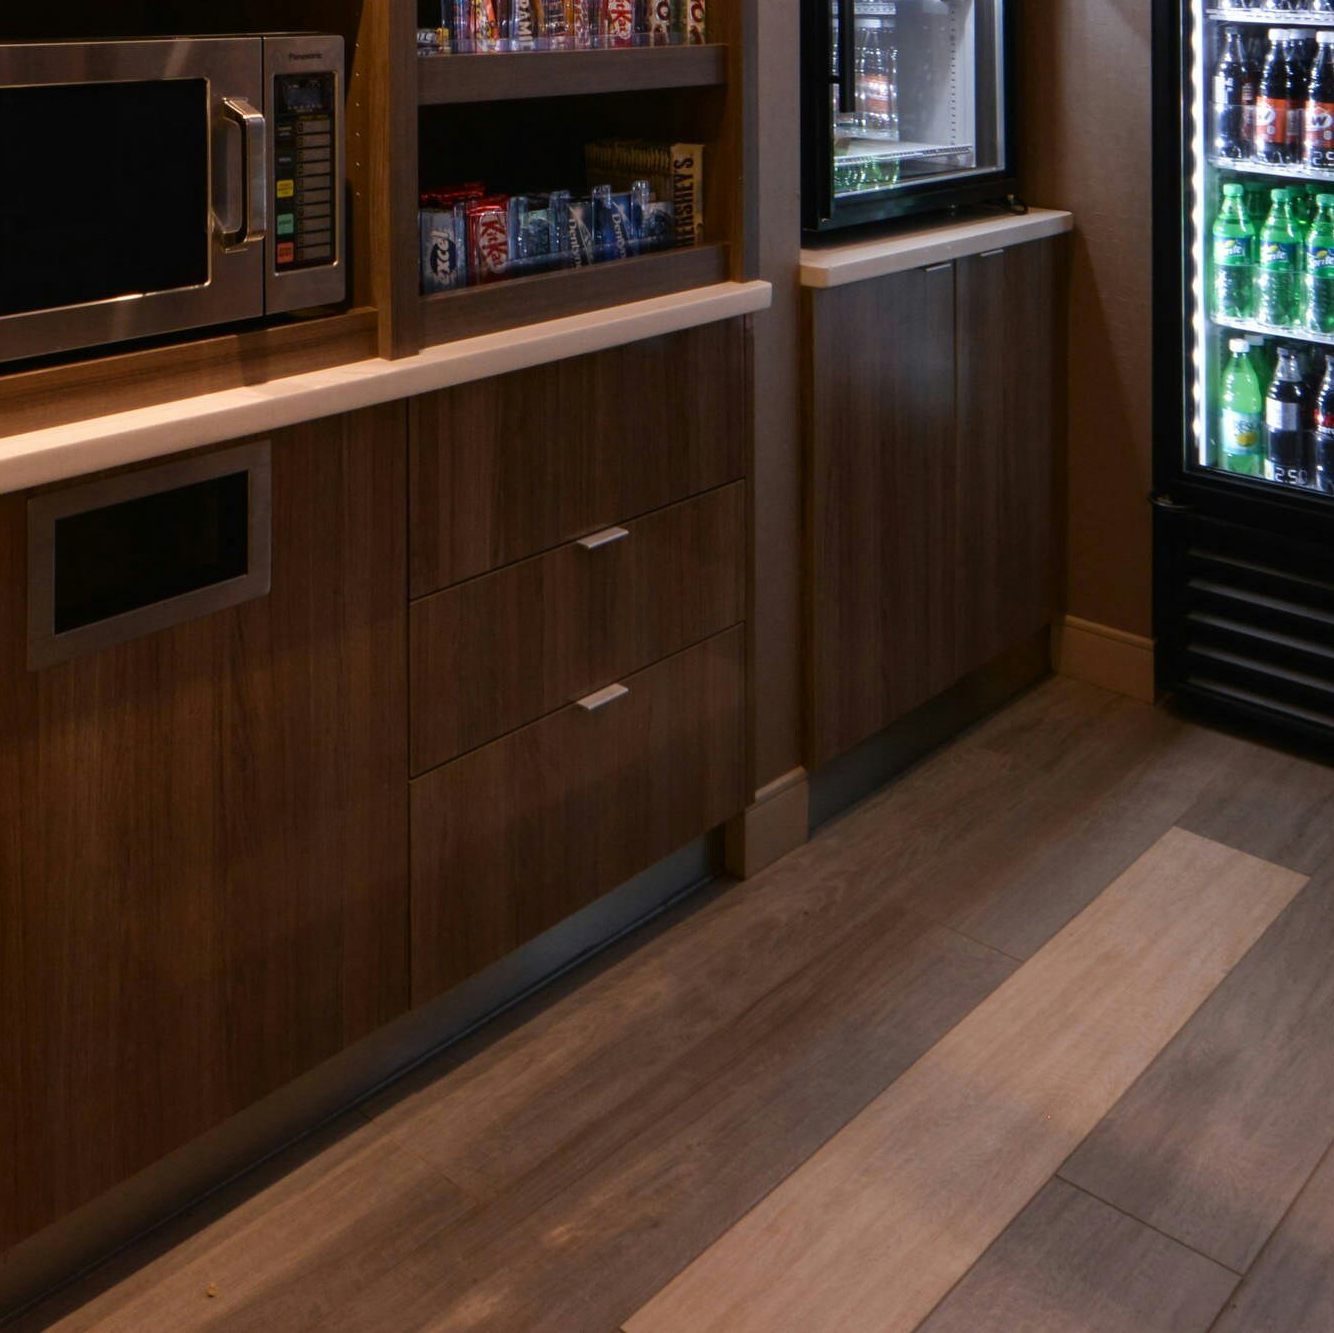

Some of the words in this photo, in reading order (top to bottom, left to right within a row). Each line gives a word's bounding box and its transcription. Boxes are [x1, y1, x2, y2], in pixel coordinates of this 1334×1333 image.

[288, 52, 323, 61] Panasonic
[569, 218, 582, 269] Dentyn
[612, 214, 627, 259] Dentyn
